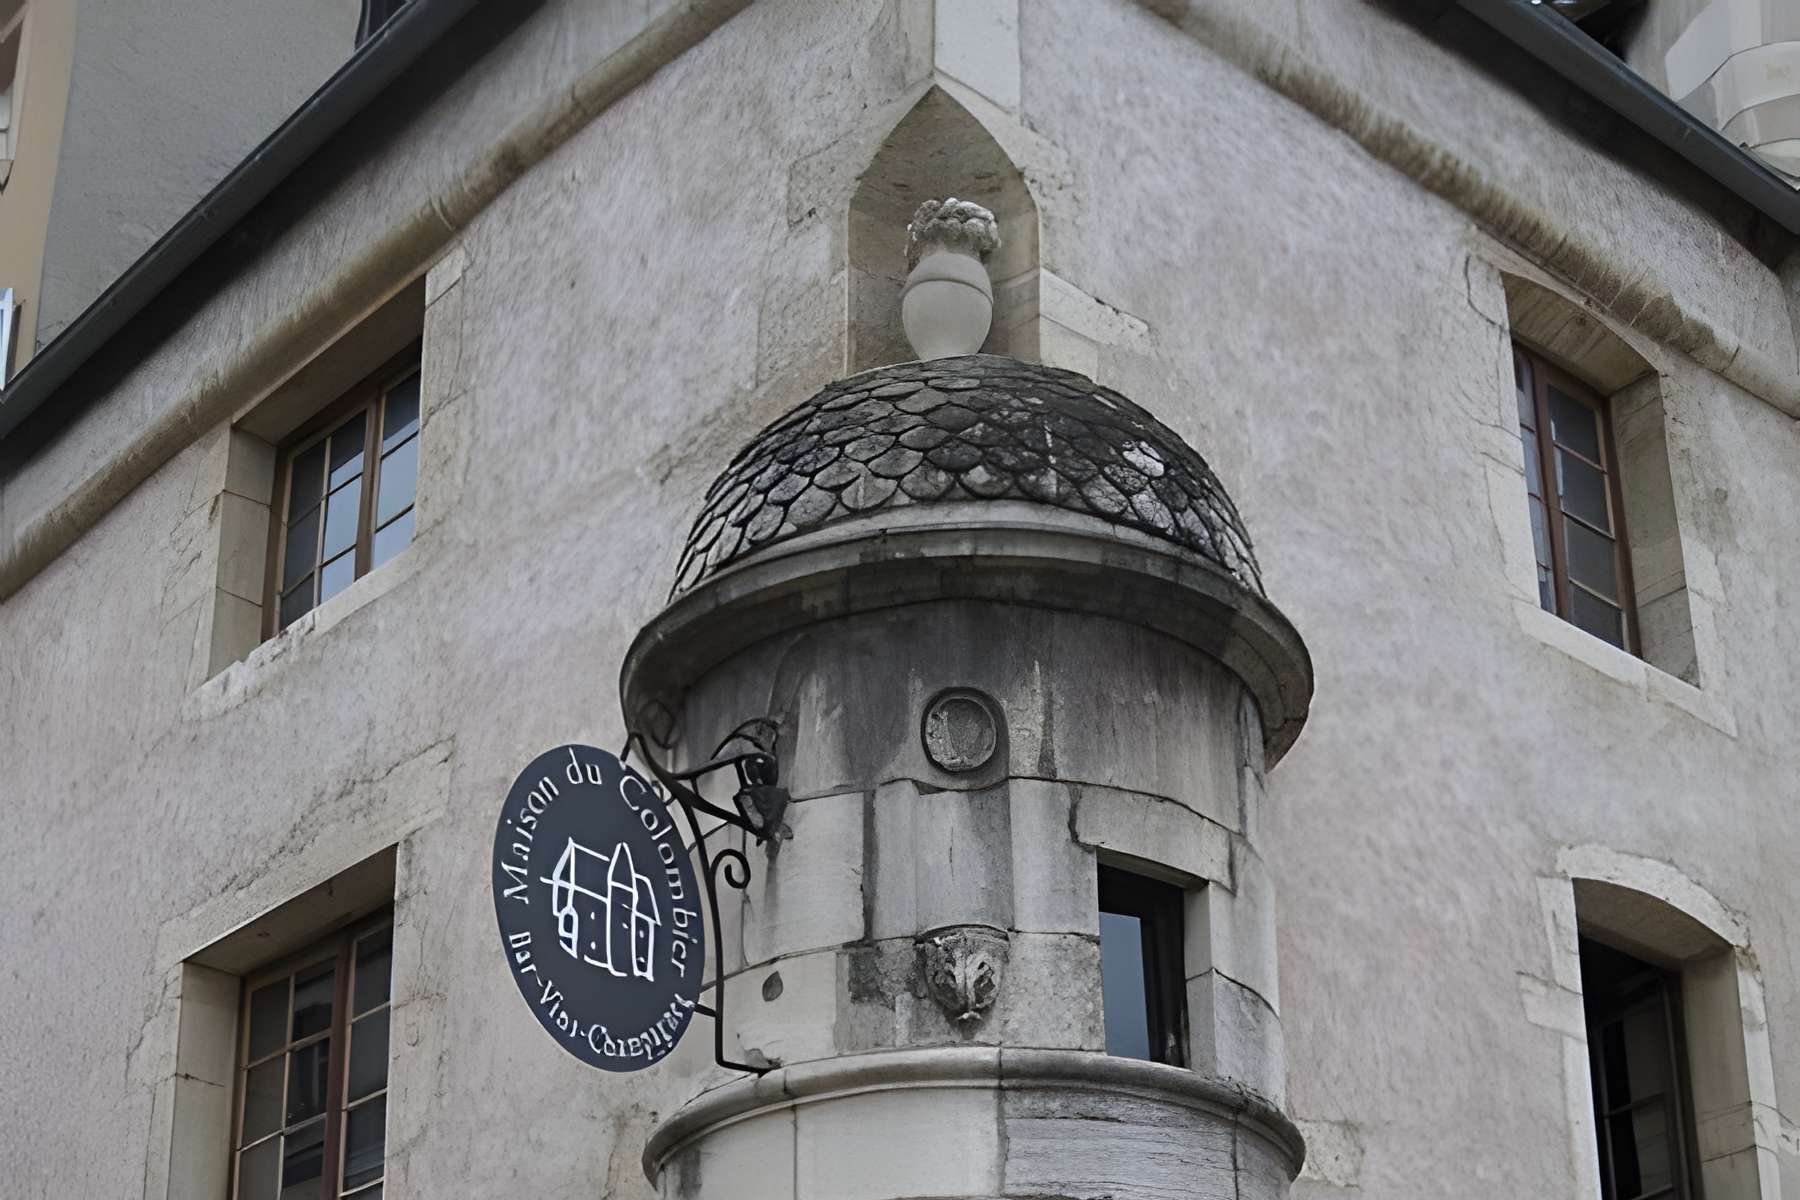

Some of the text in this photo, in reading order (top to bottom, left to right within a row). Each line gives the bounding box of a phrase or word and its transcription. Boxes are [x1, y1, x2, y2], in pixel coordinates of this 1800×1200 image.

[501, 747, 698, 978] Maison du Colombier
